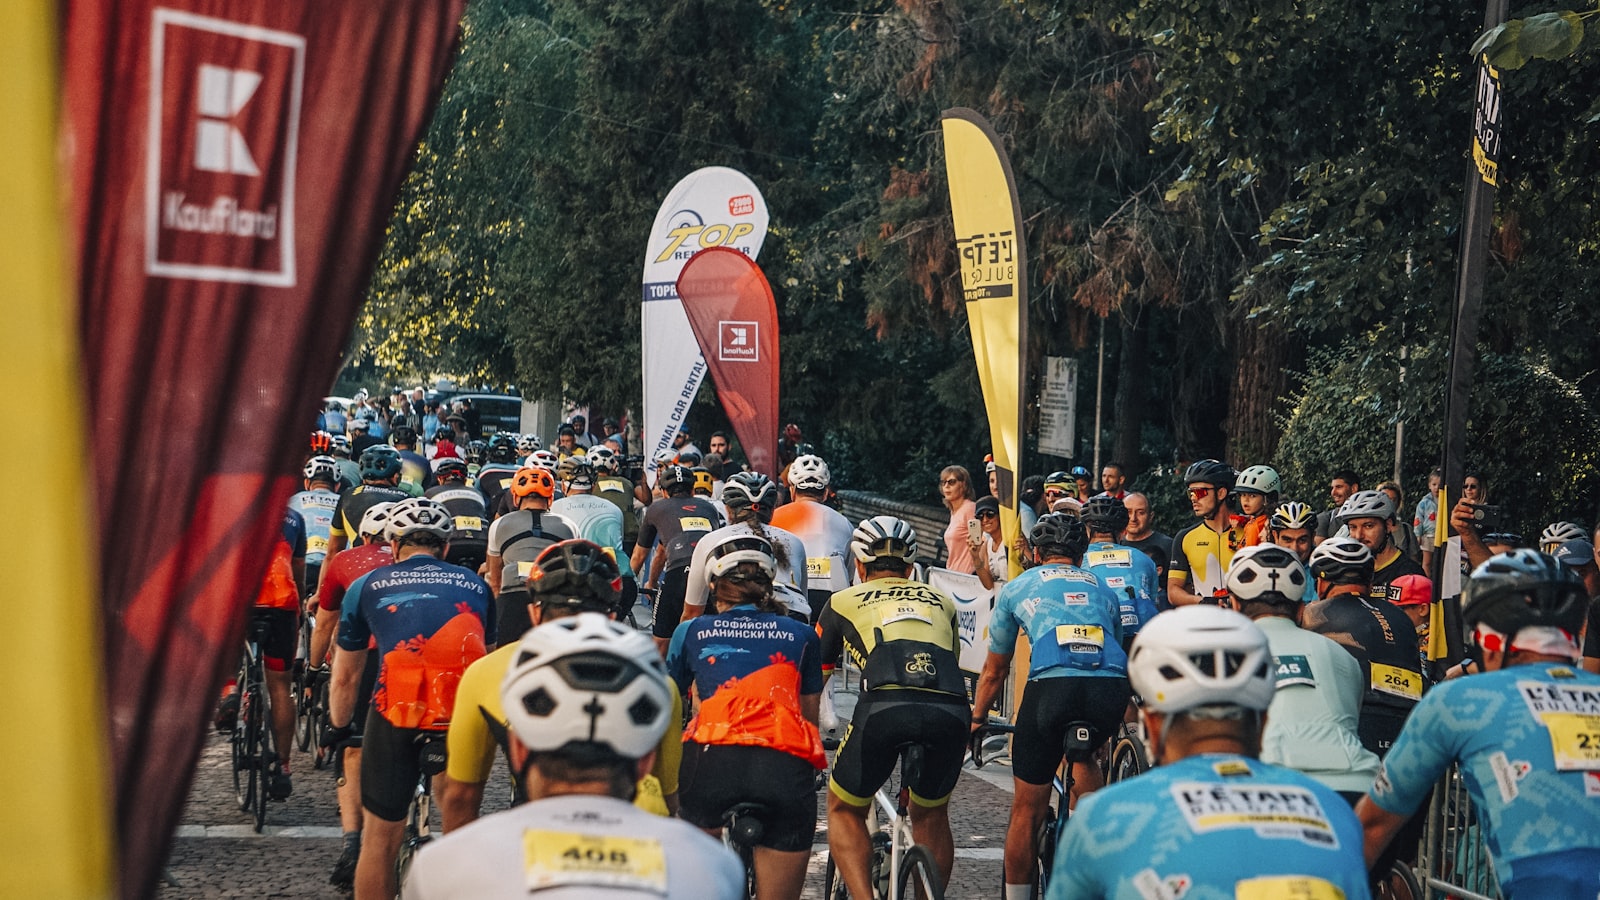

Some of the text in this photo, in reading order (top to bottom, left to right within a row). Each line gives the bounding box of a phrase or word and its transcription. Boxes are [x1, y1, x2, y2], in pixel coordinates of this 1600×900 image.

[163, 192, 277, 239] Kaufland
[653, 222, 755, 264] TOP
[648, 362, 705, 472] NAIONAL CAR RENTAL
[566, 502, 585, 511] Just
[391, 571, 465, 580] СОФИЙСКИ
[371, 578, 484, 595] ПЛАНИНСКИ КЛУБ
[714, 619, 777, 629] СОФИЙСКИ
[697, 630, 795, 641] ПЛАНИНСКИ КЛУБ
[1074, 627, 1088, 636] 81
[1275, 663, 1301, 675] 45
[1384, 674, 1410, 688] 264
[1526, 684, 1600, 704] L'ÉTA
